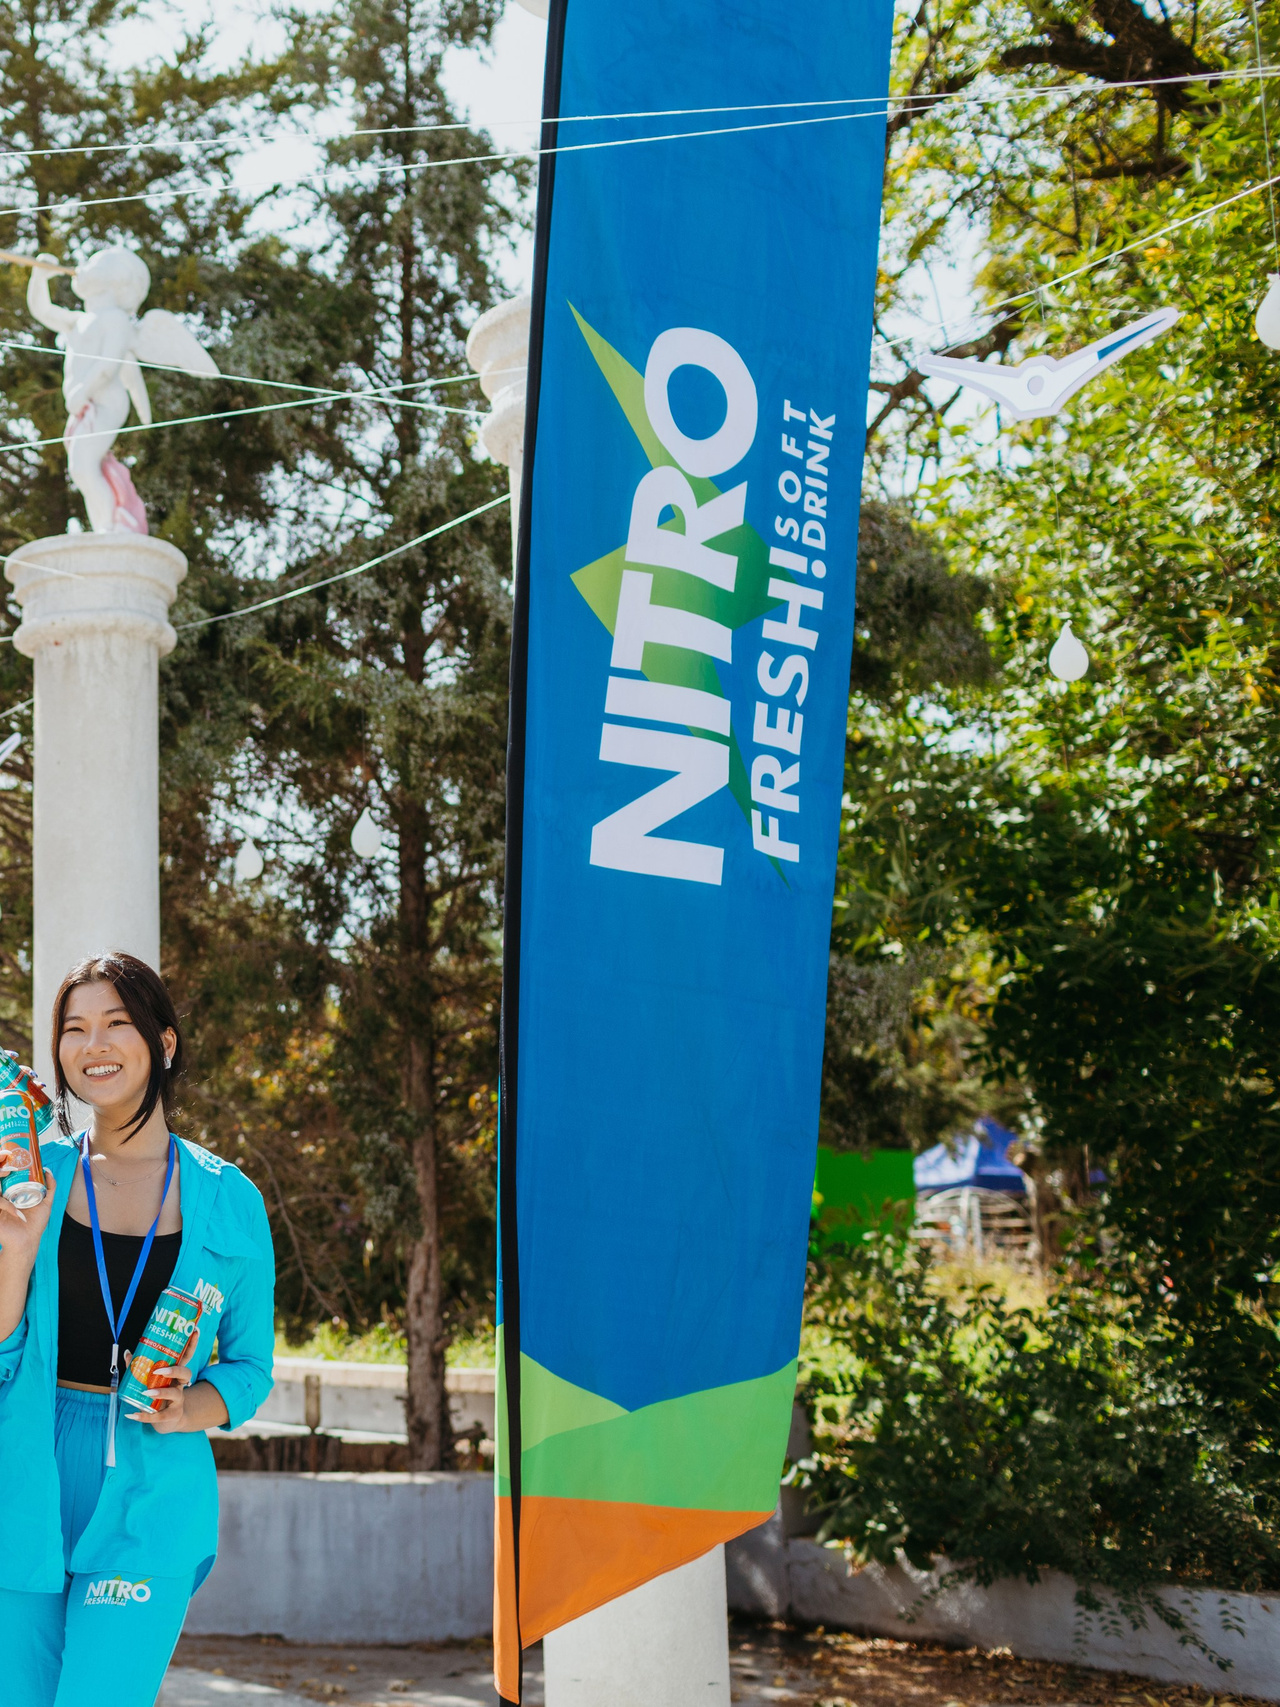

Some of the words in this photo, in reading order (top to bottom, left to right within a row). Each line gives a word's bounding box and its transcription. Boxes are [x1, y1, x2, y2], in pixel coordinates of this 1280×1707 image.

[774, 398, 807, 542] SOFT
[801, 407, 837, 551] DRINK
[589, 326, 758, 886] NITRO
[750, 545, 827, 863] FRESH!
[150, 1305, 196, 1338] NITRO
[85, 1579, 152, 1603] NITRO
